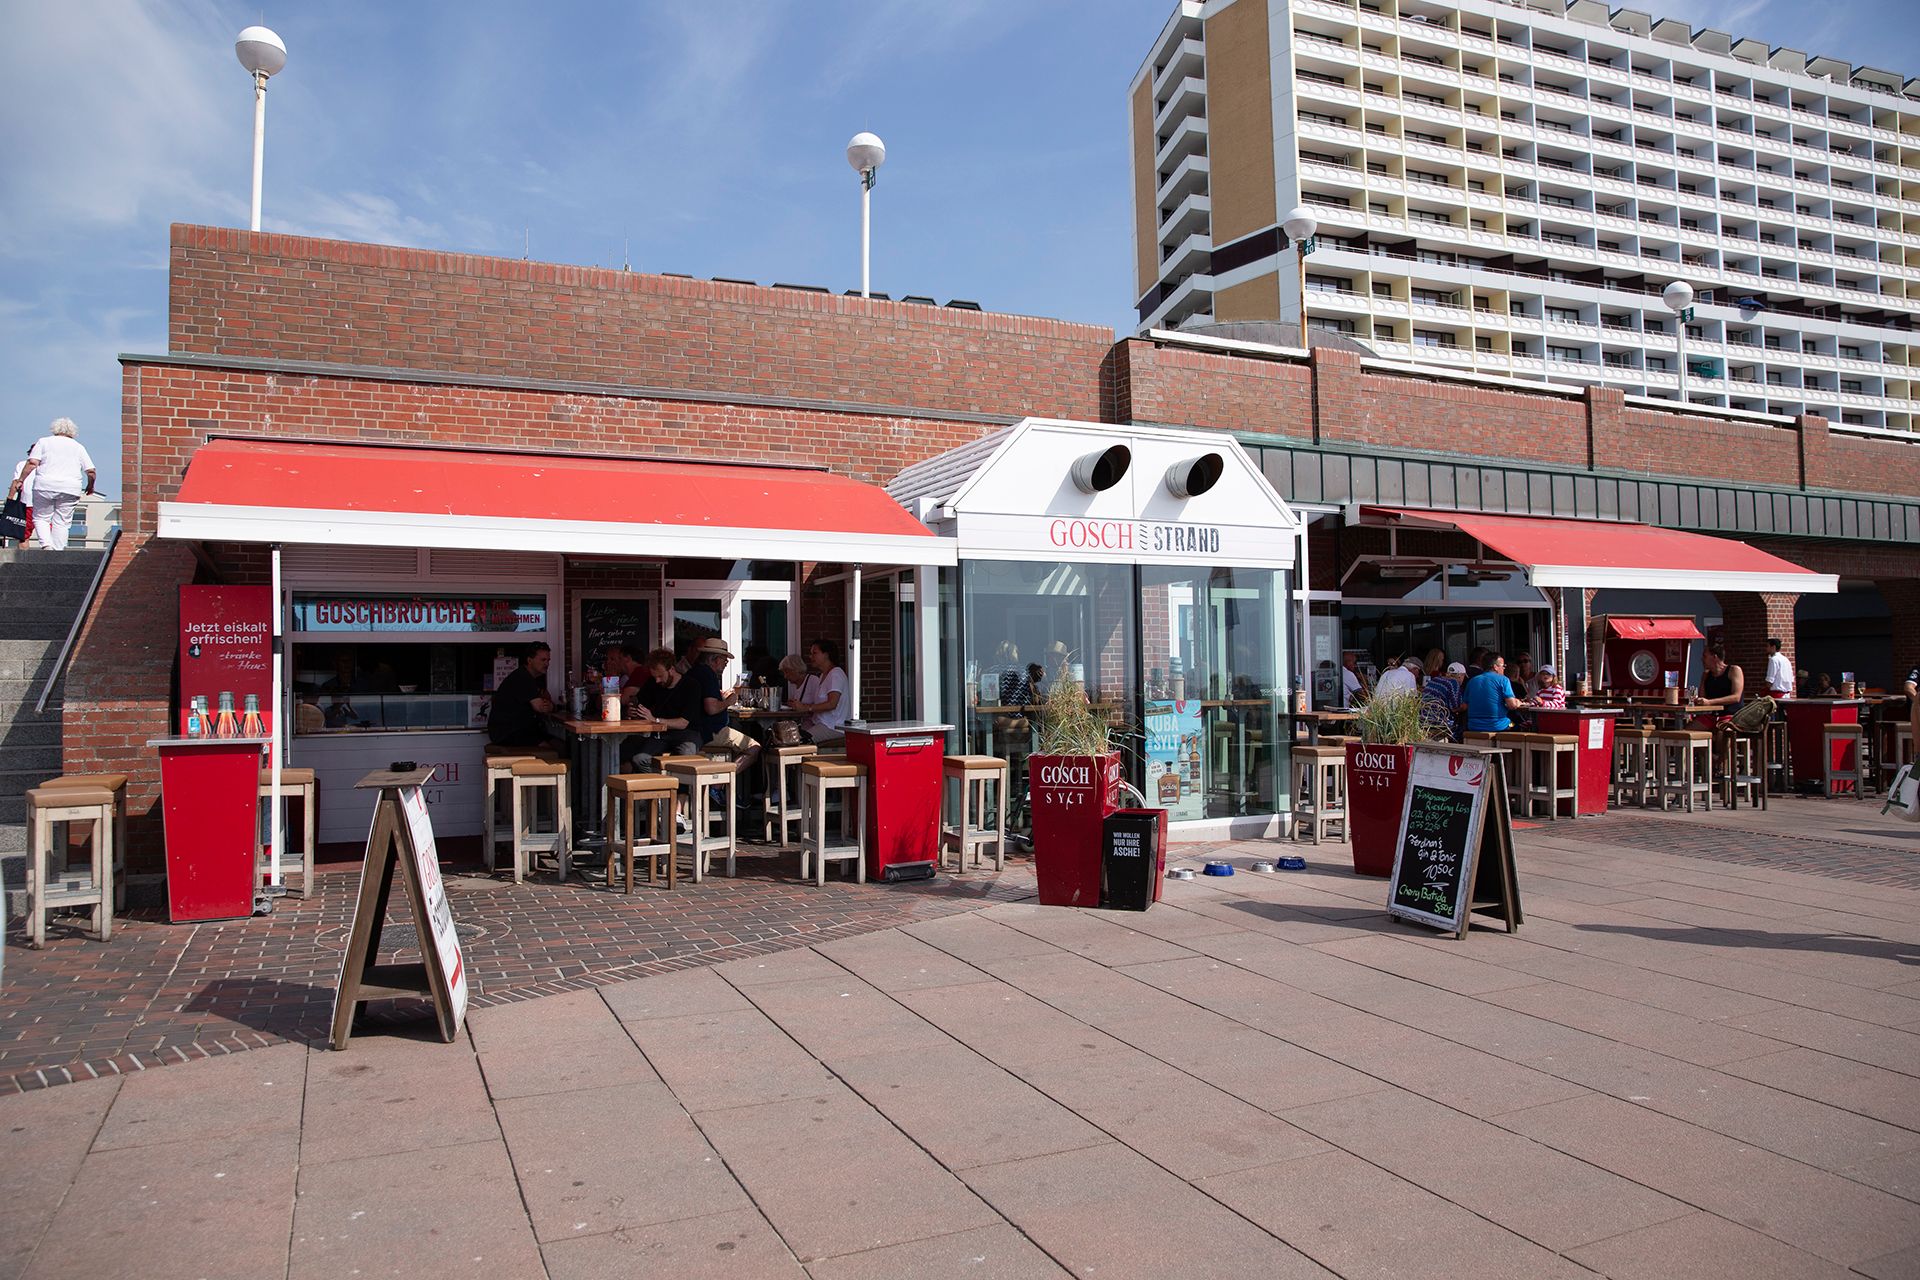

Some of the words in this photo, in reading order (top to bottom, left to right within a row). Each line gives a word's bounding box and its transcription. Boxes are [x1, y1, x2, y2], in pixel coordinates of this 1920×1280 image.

[1050, 519, 1133, 549] GOSCH
[1153, 526, 1211, 553] STRAND
[316, 597, 487, 624] GOSCHBRÖTCHEN
[184, 622, 220, 633] Jetzt
[223, 622, 267, 633] eiskalt
[190, 634, 262, 645] erfrischen!
[1146, 714, 1179, 732] KUBA
[1153, 734, 1179, 751] SYLT
[1355, 752, 1396, 770] GOSCH
[1041, 765, 1090, 785] GOSCH
[1046, 791, 1084, 811] SYLT
[1113, 839, 1125, 847] NUR
[1113, 847, 1140, 857] ASCHE!
[1438, 850, 1457, 862] Tonic
